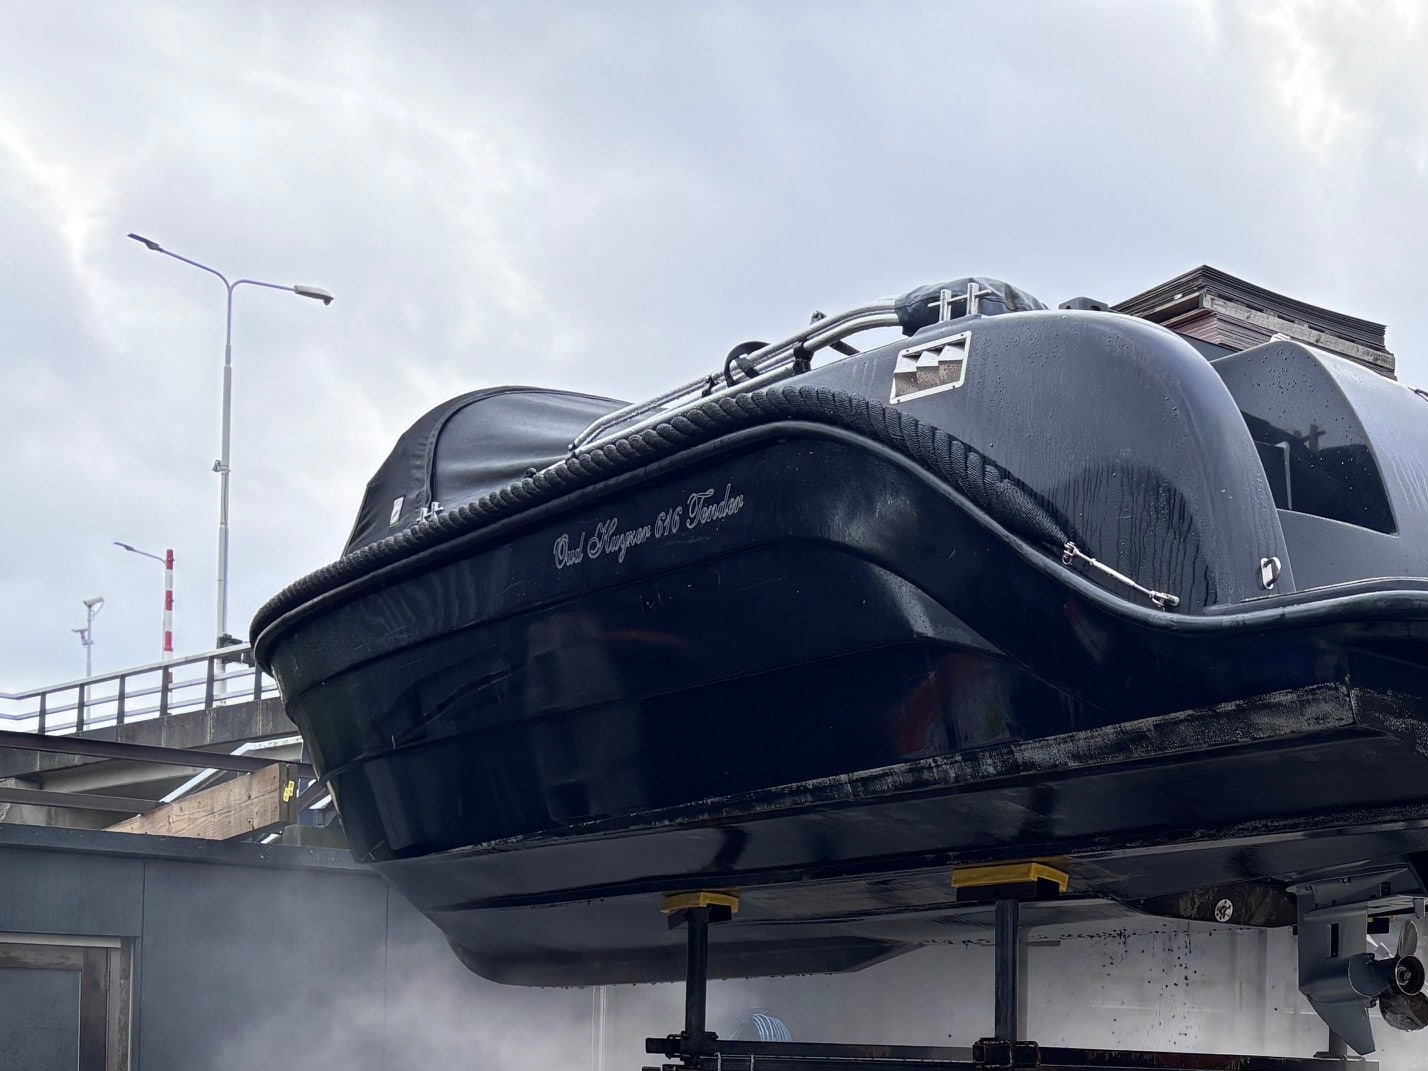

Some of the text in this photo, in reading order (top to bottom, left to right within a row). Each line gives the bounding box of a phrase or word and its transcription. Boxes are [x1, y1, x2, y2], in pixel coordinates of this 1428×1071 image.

[552, 531, 586, 570] Oud
[654, 506, 683, 539] 616
[685, 482, 744, 530] Tender
